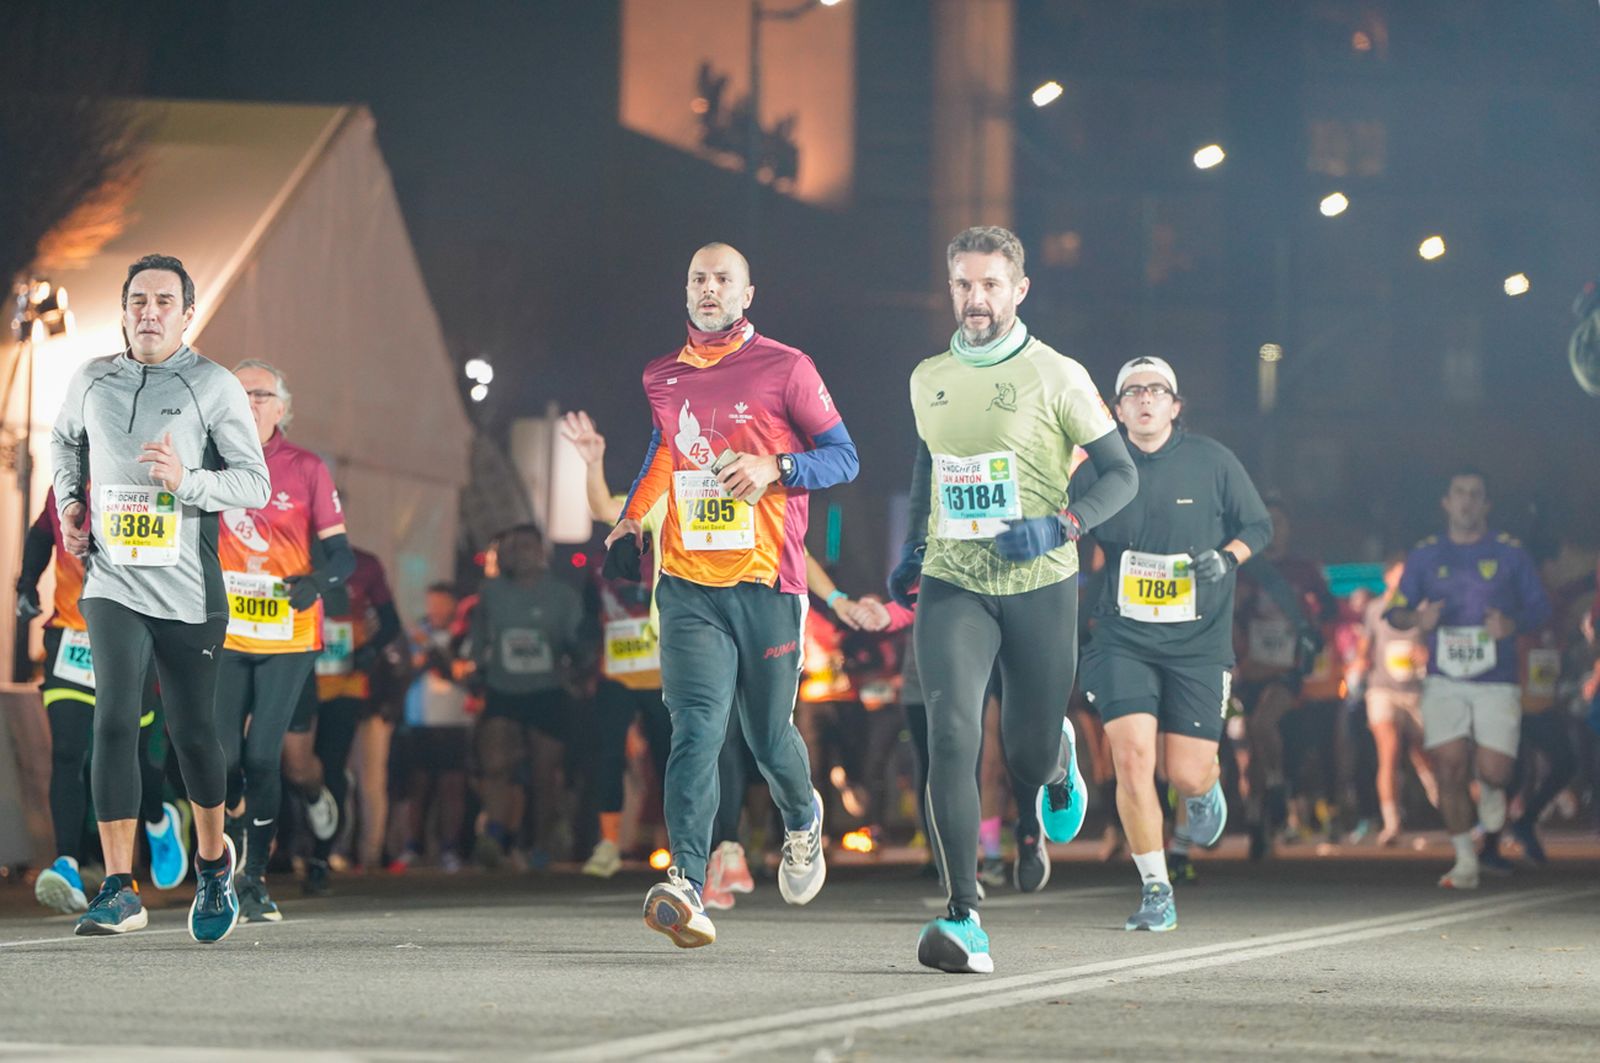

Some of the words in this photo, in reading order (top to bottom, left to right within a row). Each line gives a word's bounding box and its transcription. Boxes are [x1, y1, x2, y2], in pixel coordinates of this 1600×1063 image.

[689, 442, 709, 465] 43
[114, 494, 138, 503] OCHE
[139, 495, 150, 503] DE
[945, 484, 1006, 510] 13184
[686, 499, 735, 522] 7495
[110, 513, 165, 538] 3384
[234, 520, 254, 540] 43
[1136, 579, 1178, 599] 1784
[235, 596, 278, 617] 3010
[763, 640, 797, 659] PUMA
